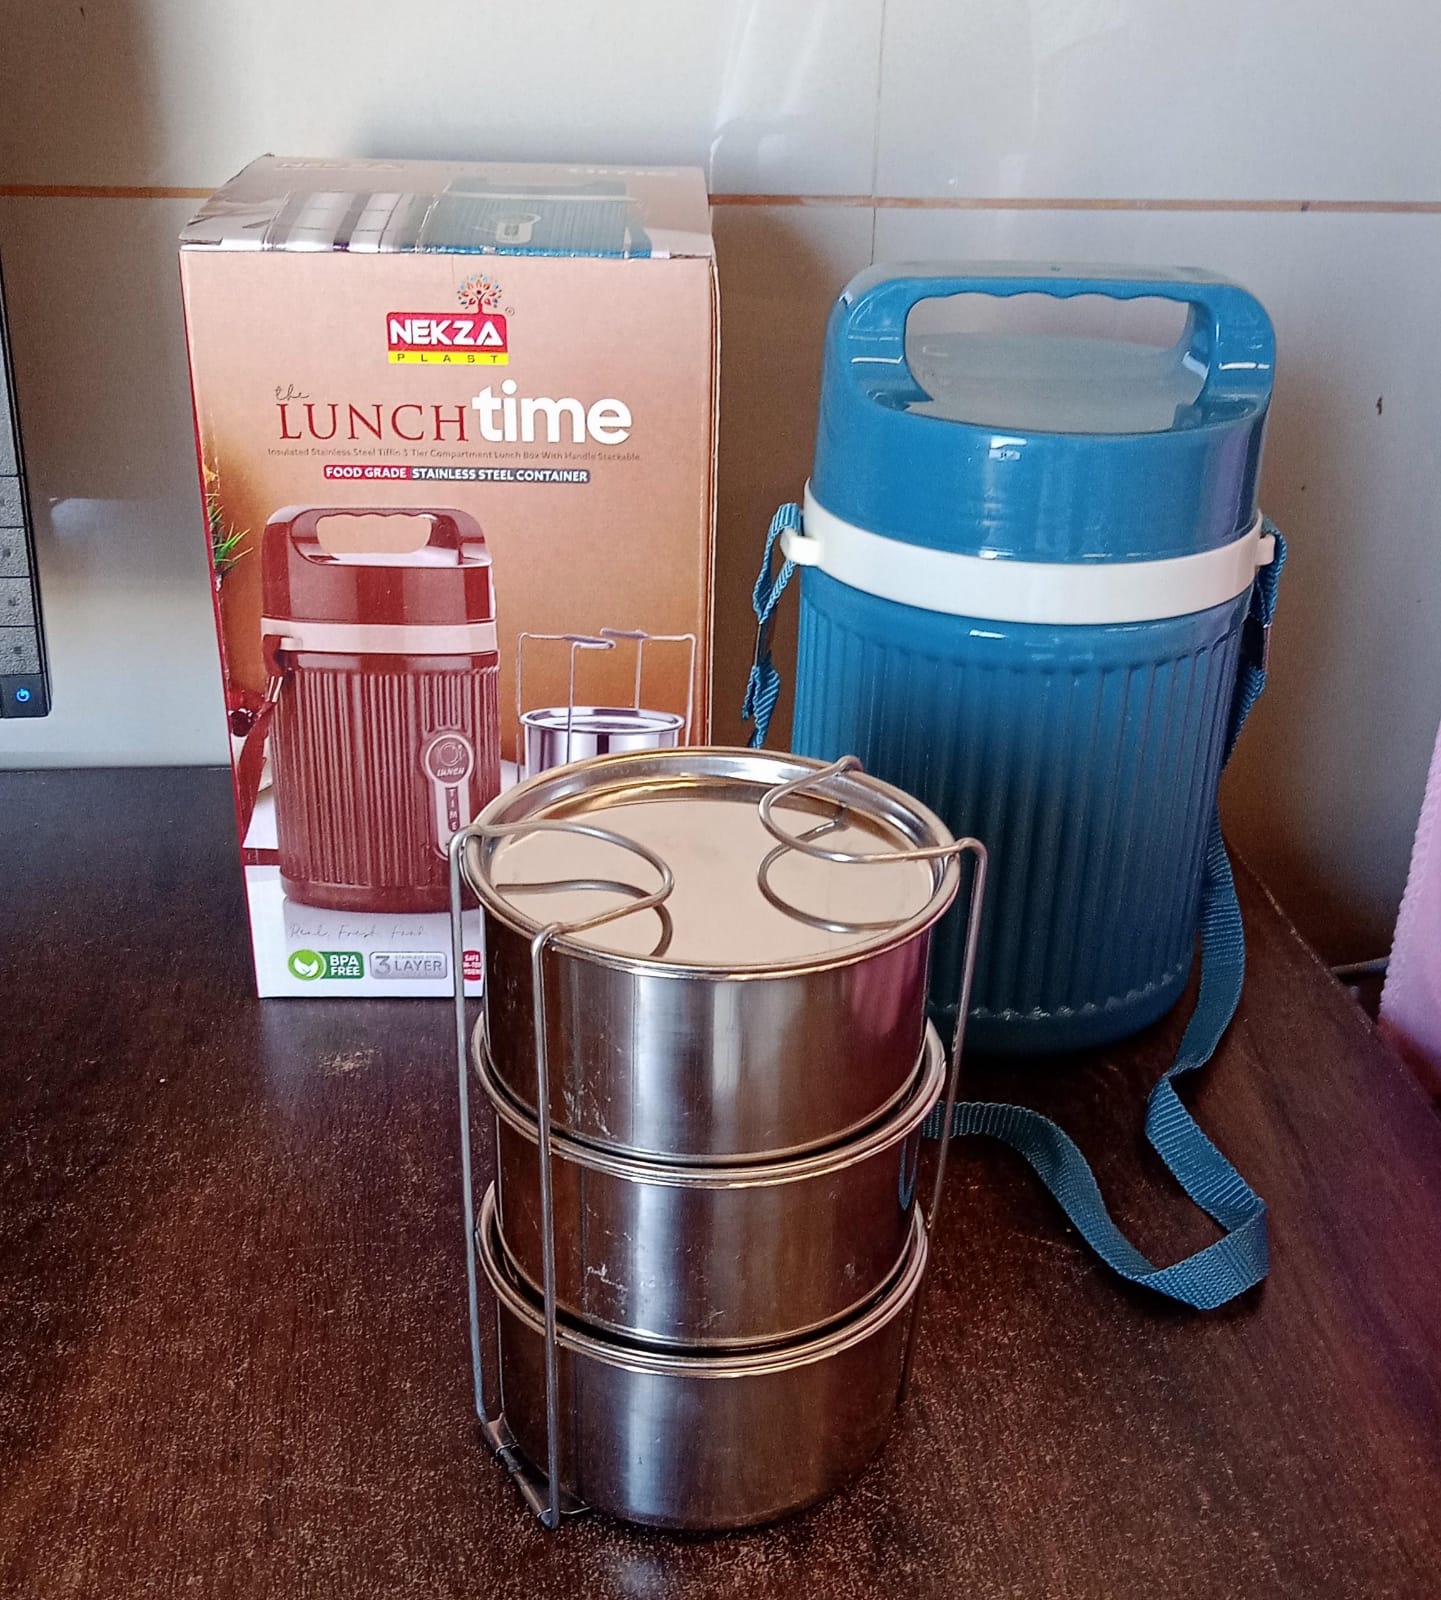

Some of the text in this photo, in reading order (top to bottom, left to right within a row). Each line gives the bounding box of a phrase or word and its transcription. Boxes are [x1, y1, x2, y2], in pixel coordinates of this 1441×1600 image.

[389, 319, 504, 346] NEKZA
[397, 353, 498, 363] PLAST
[275, 384, 309, 401] the
[276, 379, 632, 445] LUNCH time
[268, 448, 309, 457] Insulated
[312, 448, 351, 457] Stainless
[354, 448, 376, 457] Steel
[412, 449, 428, 457] Tier
[430, 450, 492, 460] Compartment
[494, 451, 521, 459] Lunch
[541, 452, 563, 460] With
[325, 466, 588, 483] FOOD GRADE STAINLESS STEEL CONTAINER
[329, 954, 358, 966] BPA
[374, 955, 443, 976] 3 LAYER
[331, 966, 360, 977] FREE
